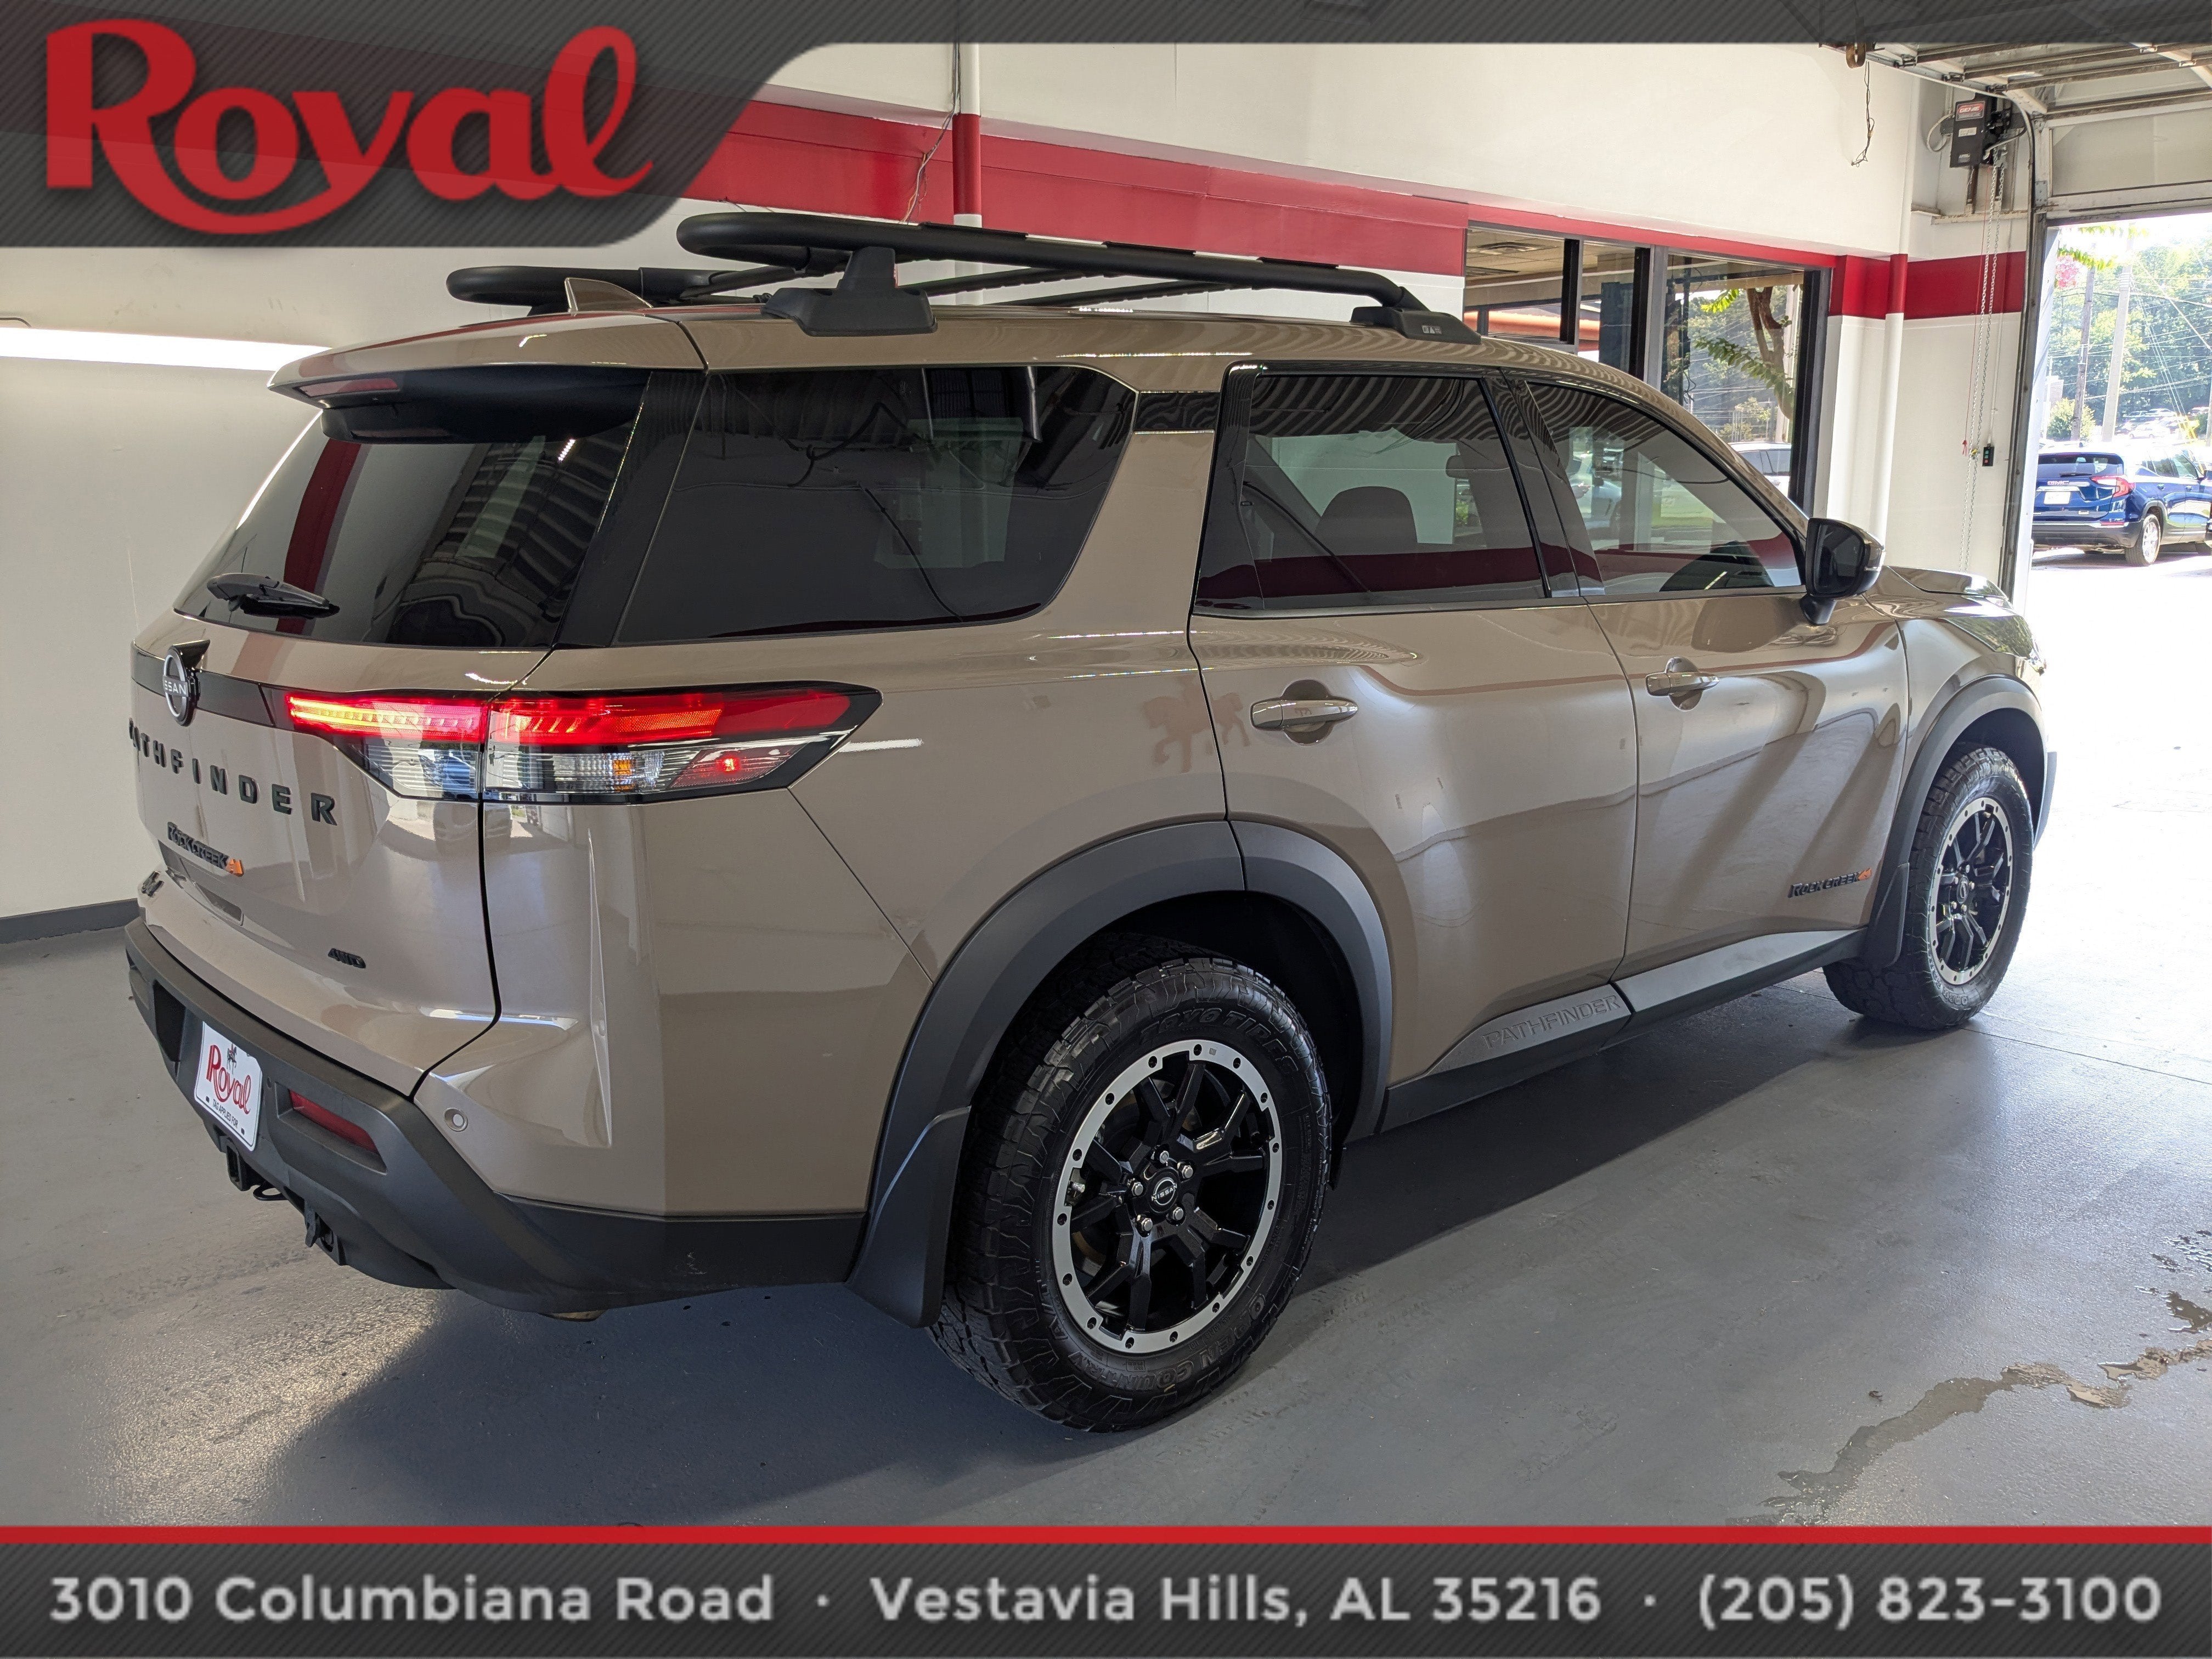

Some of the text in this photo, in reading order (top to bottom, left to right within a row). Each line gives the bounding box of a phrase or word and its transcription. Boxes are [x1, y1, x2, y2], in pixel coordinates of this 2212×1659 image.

[1787, 871, 1860, 898] ROCK CREEK
[1482, 995, 1621, 1049] PATHFINDER
[206, 1045, 252, 1115] Royal
[219, 1105, 232, 1123] APPLIED
[1151, 1182, 1177, 1201] NISSAN
